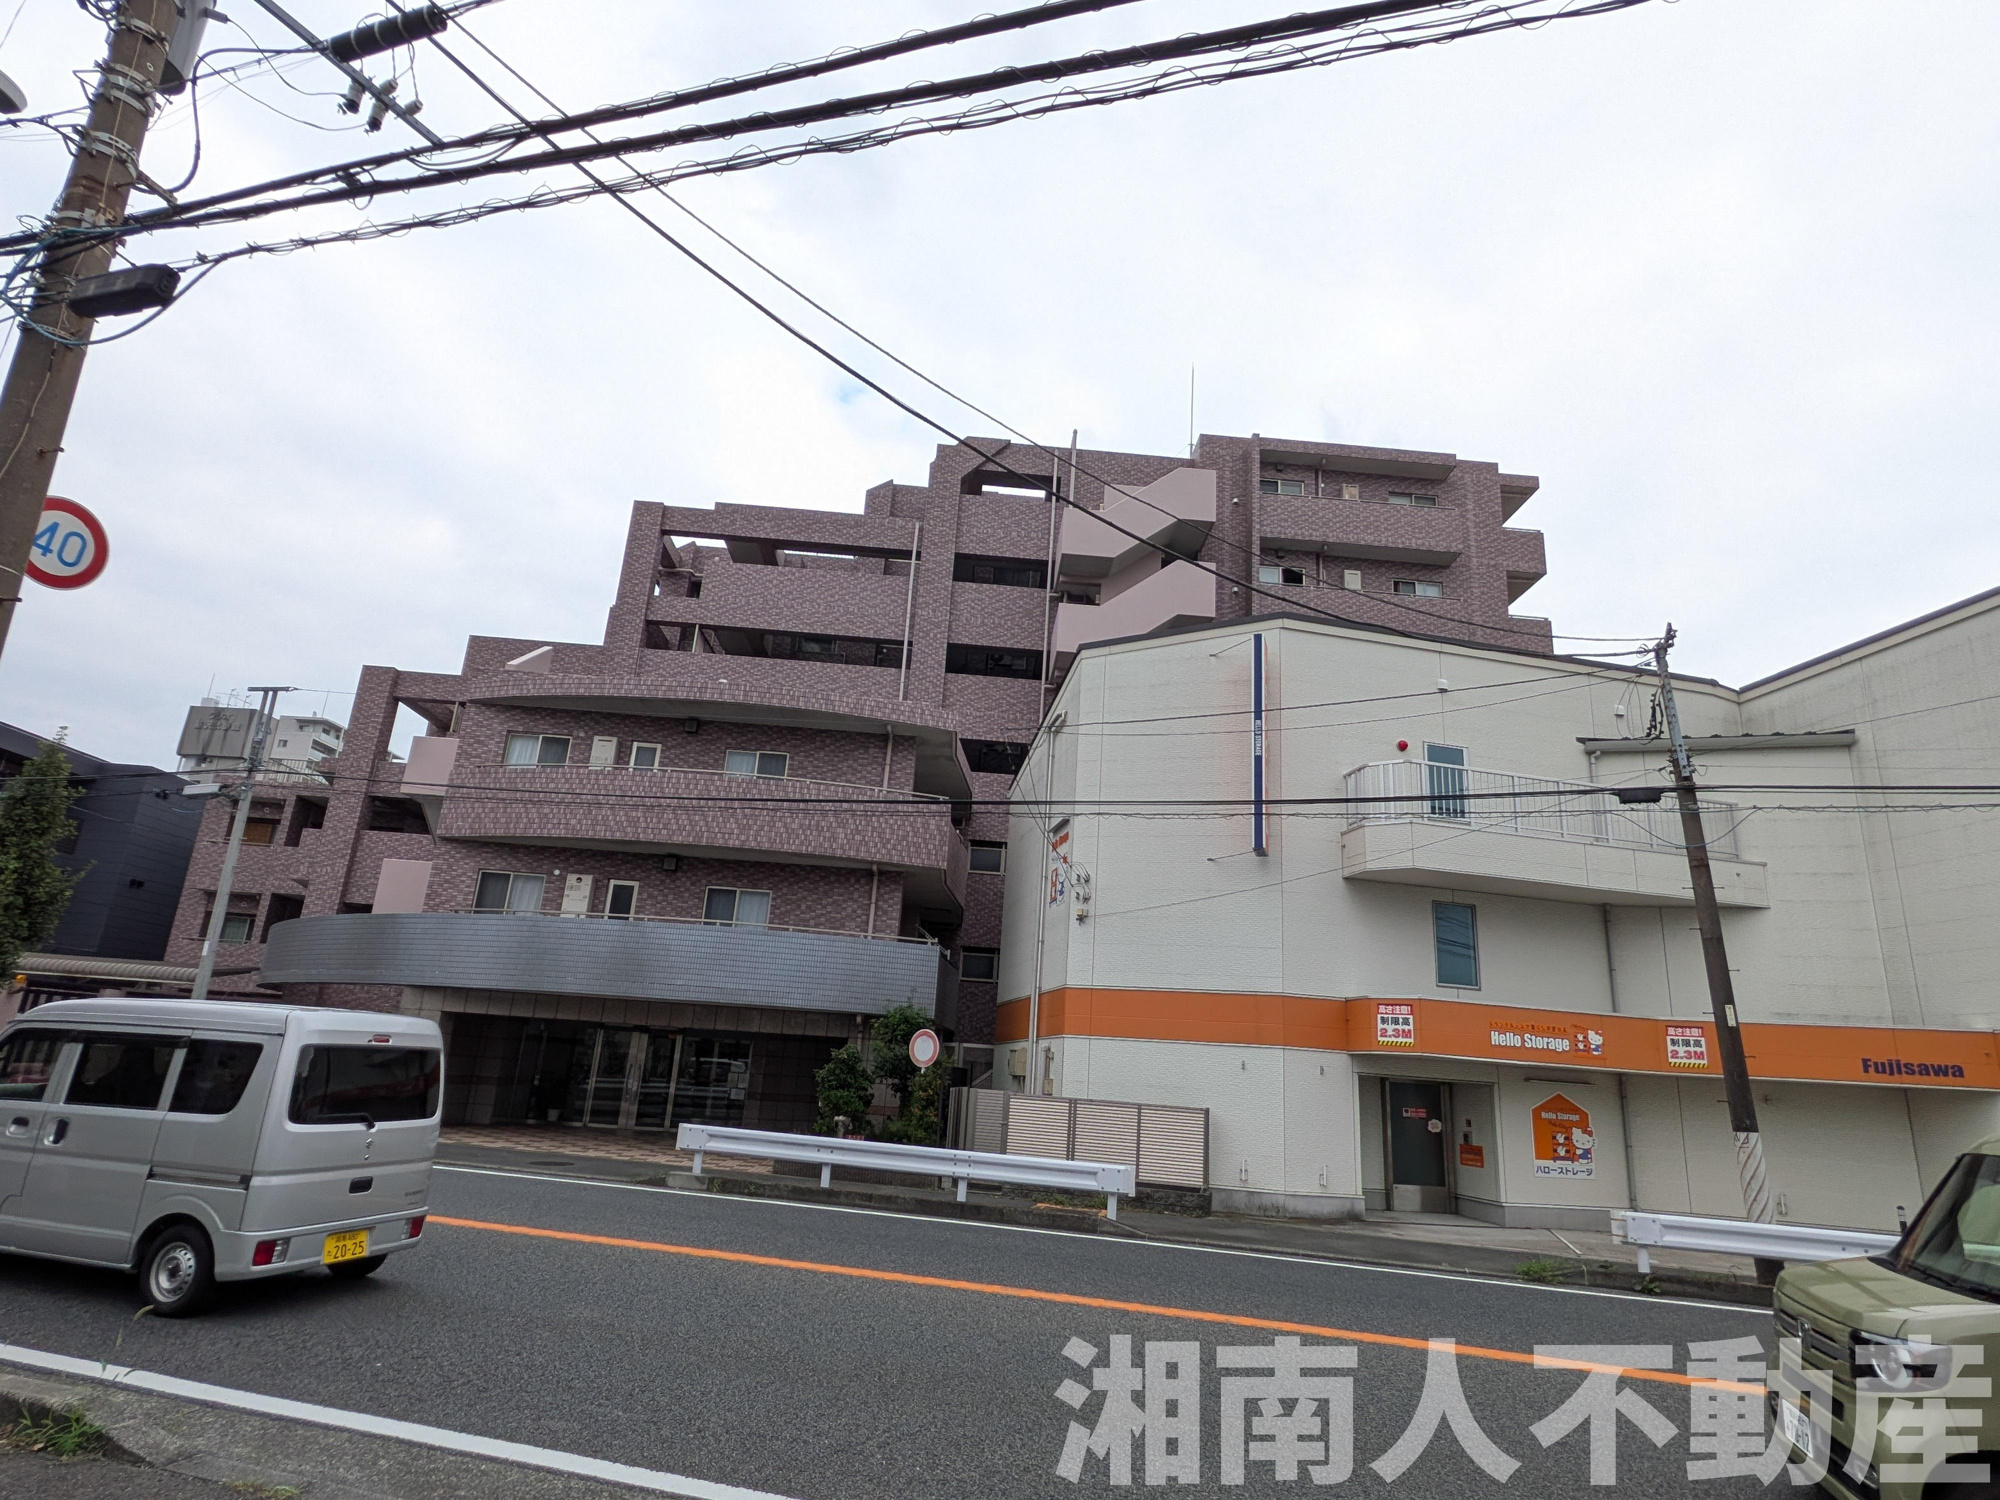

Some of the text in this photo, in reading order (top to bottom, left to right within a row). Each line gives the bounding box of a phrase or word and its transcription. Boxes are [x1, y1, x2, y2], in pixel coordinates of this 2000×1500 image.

[32, 521, 87, 568] 40
[1379, 1016, 1411, 1026] 制限高
[1379, 1028, 1413, 1039] 2.3M
[1490, 1030, 1571, 1052] Hello Storage
[1669, 1038, 1703, 1048] 制限高
[1670, 1049, 1706, 1061] 2.3M
[1861, 1057, 1965, 1078] Fujisawa
[1541, 1111, 1580, 1122] Hello Storage
[1535, 1165, 1593, 1177] ハローストレージ
[333, 1241, 365, 1260] 20-25
